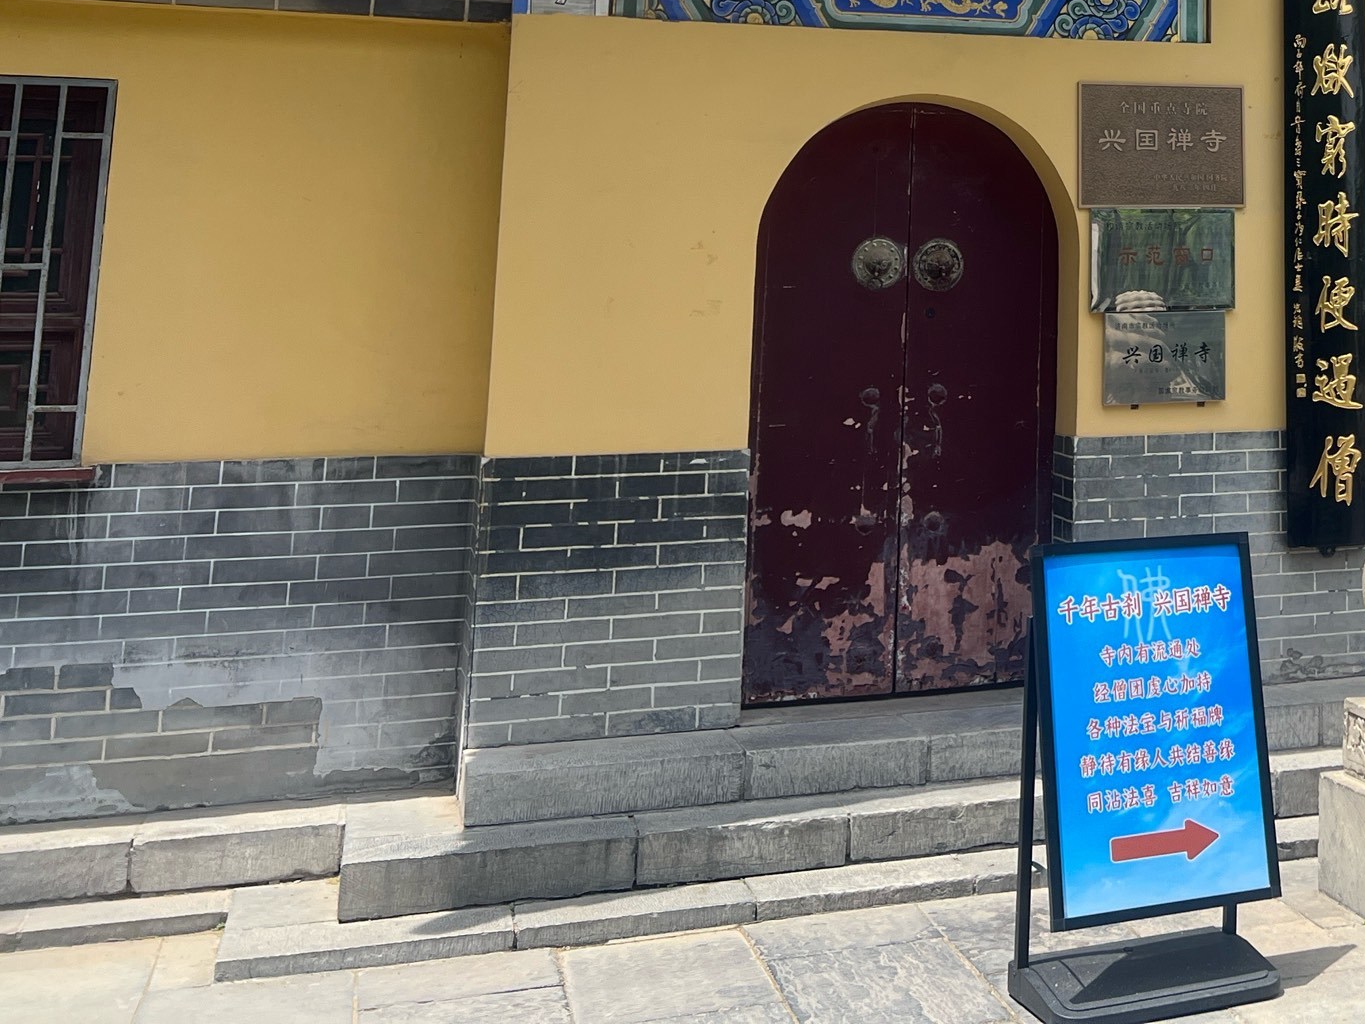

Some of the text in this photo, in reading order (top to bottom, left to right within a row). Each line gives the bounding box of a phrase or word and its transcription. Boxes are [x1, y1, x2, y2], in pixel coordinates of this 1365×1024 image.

[1098, 127, 1227, 153] 兴国禅寺
[1122, 341, 1211, 364] 兴国禅寺
[1057, 583, 1232, 625] 千年古刹 兴国禅寺
[1099, 637, 1201, 666] 寺内有流通处
[1093, 671, 1212, 704] 经僧团虔心加持
[1086, 704, 1224, 743] 各种法宝与祈福牌
[1080, 738, 1236, 779] 静待有缘人共结善缘
[1087, 773, 1235, 814] 同沾法喜 吉祥如意
